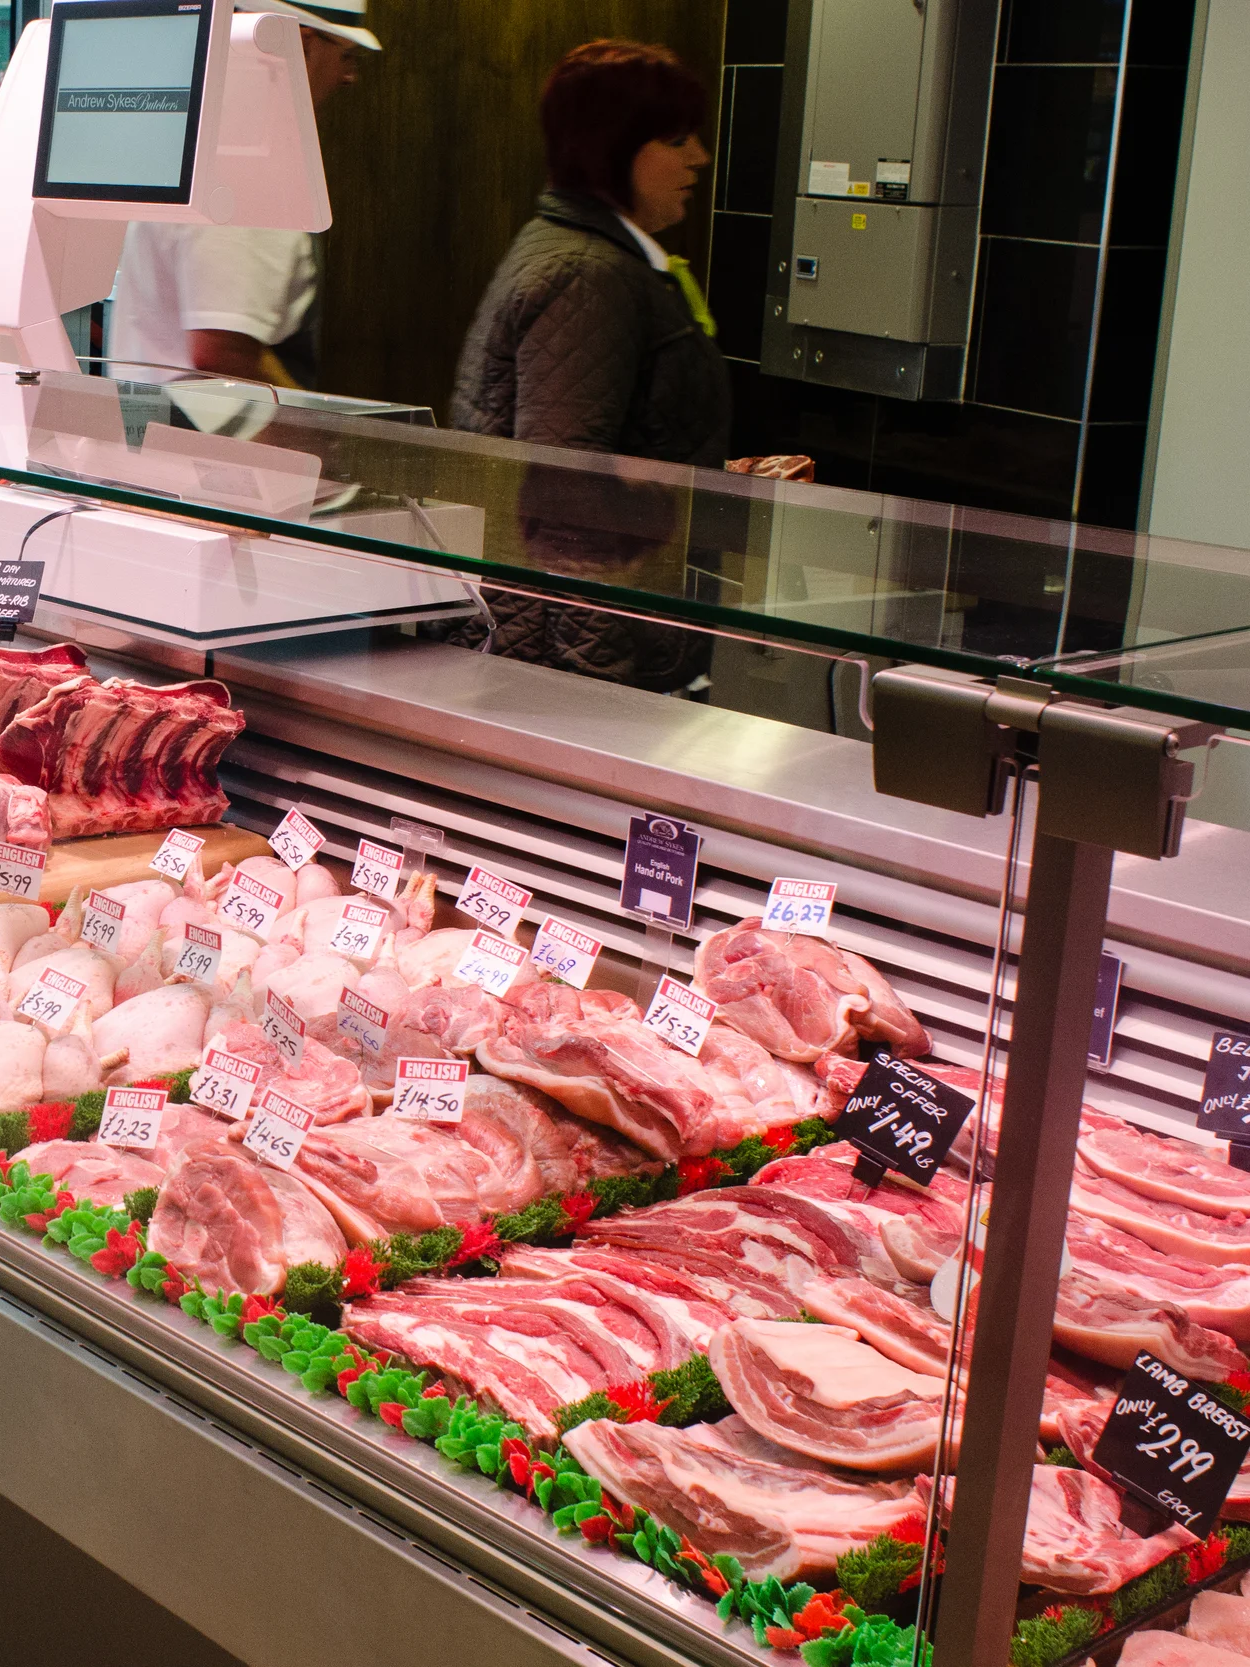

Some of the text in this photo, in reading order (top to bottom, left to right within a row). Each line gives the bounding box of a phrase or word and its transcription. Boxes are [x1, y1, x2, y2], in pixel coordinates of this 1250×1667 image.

[68, 94, 105, 108] Andrew
[107, 93, 136, 112] Sykes
[3, 565, 21, 574] DAY
[169, 834, 200, 851] ENGLISH
[288, 812, 320, 847] ENGLISH
[638, 834, 663, 844] ANDREW
[664, 840, 684, 851] SYKES
[152, 849, 185, 873] £5.50
[271, 831, 304, 863] £5.50
[362, 844, 398, 867] ENGLISH
[352, 864, 389, 891] £5.99
[634, 863, 684, 887] Hand of Pork
[650, 859, 670, 870] English
[237, 875, 280, 908] ENGLISH
[476, 872, 525, 905] ENGLISH
[778, 881, 829, 898] ENGLISH
[93, 894, 125, 919] ENGLISH
[222, 895, 265, 930] £5.99
[347, 905, 383, 925] ENGLISH
[460, 891, 510, 926] £5.99
[768, 901, 826, 923] £6.27
[82, 914, 116, 945] £5.99
[188, 928, 220, 949] ENGLISH
[331, 925, 369, 951] £5.99
[548, 922, 596, 953] ENGLISH
[177, 945, 212, 969] £5.99
[479, 936, 522, 963] ENGLISH
[533, 944, 577, 974] £6.69
[44, 970, 83, 997] ENGLISH
[459, 959, 509, 988] £4.99
[17, 990, 62, 1021] £5.99
[345, 992, 384, 1025] ENGLISH
[665, 978, 712, 1018] ENGLISH
[270, 994, 301, 1035] ENGLISH
[646, 1004, 700, 1047] £15.32
[263, 1016, 297, 1056] £5.25
[339, 1014, 379, 1051] £4.60
[210, 1050, 257, 1081] ENGLISH
[405, 1062, 461, 1081] ENGLISH
[874, 1053, 937, 1098] SPECIAL
[113, 1092, 160, 1109] ENGLISH
[191, 1075, 237, 1110] £3.31
[394, 1084, 458, 1113] £14.50
[890, 1082, 948, 1124] OFFER
[1204, 1093, 1239, 1114] ONLY
[265, 1093, 310, 1129] ENGLISH
[100, 1112, 151, 1141] £2.23
[246, 1116, 294, 1157] £4.65
[845, 1095, 935, 1169] ONLY £1.49 LB
[1116, 1398, 1156, 1417] ONLY
[1135, 1354, 1250, 1441] LAMB BREAST
[1157, 1489, 1202, 1526] EACH
